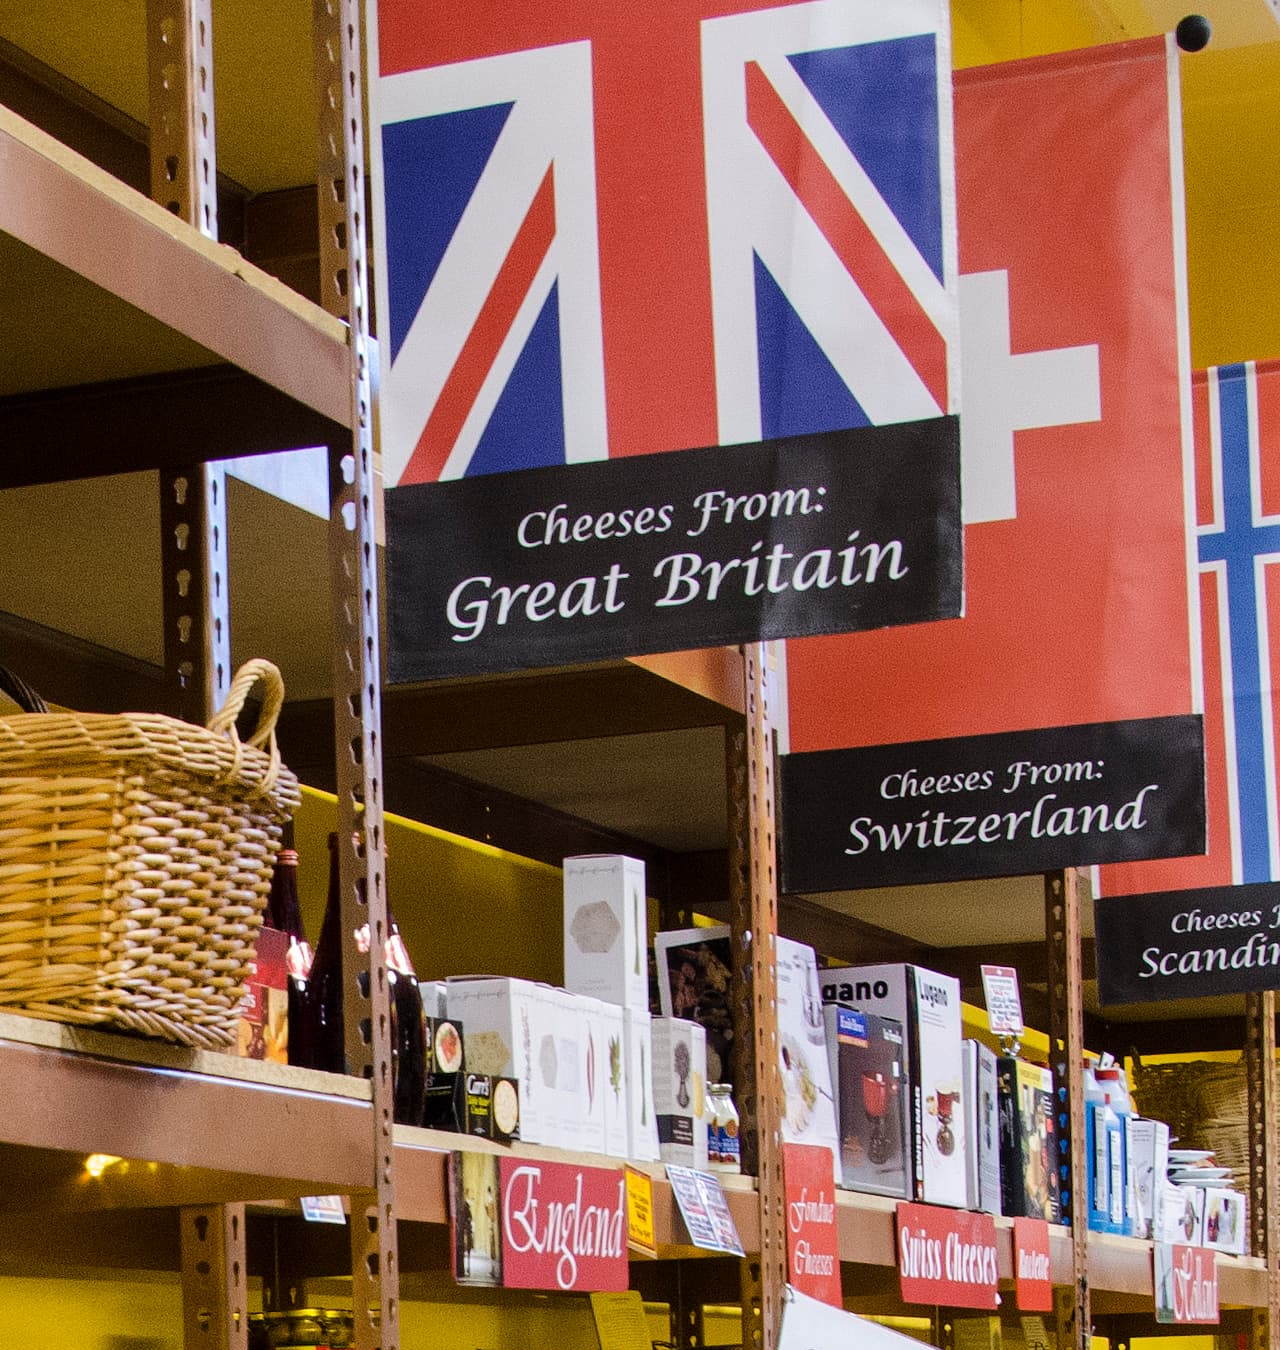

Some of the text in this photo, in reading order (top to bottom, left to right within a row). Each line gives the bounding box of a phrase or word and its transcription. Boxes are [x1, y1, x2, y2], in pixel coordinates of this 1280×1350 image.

[517, 484, 826, 549] Cheeses From:
[445, 530, 910, 643] Great Britain
[879, 756, 1106, 801] Cheeses From:
[845, 784, 1159, 855] Switzerland
[1170, 905, 1262, 935] Cheeses
[821, 979, 889, 1002] gano
[504, 1165, 625, 1290] England
[789, 1187, 835, 1233] Fondue
[794, 1239, 834, 1276] Cheeses
[900, 1225, 998, 1286] Swiss Cheeses
